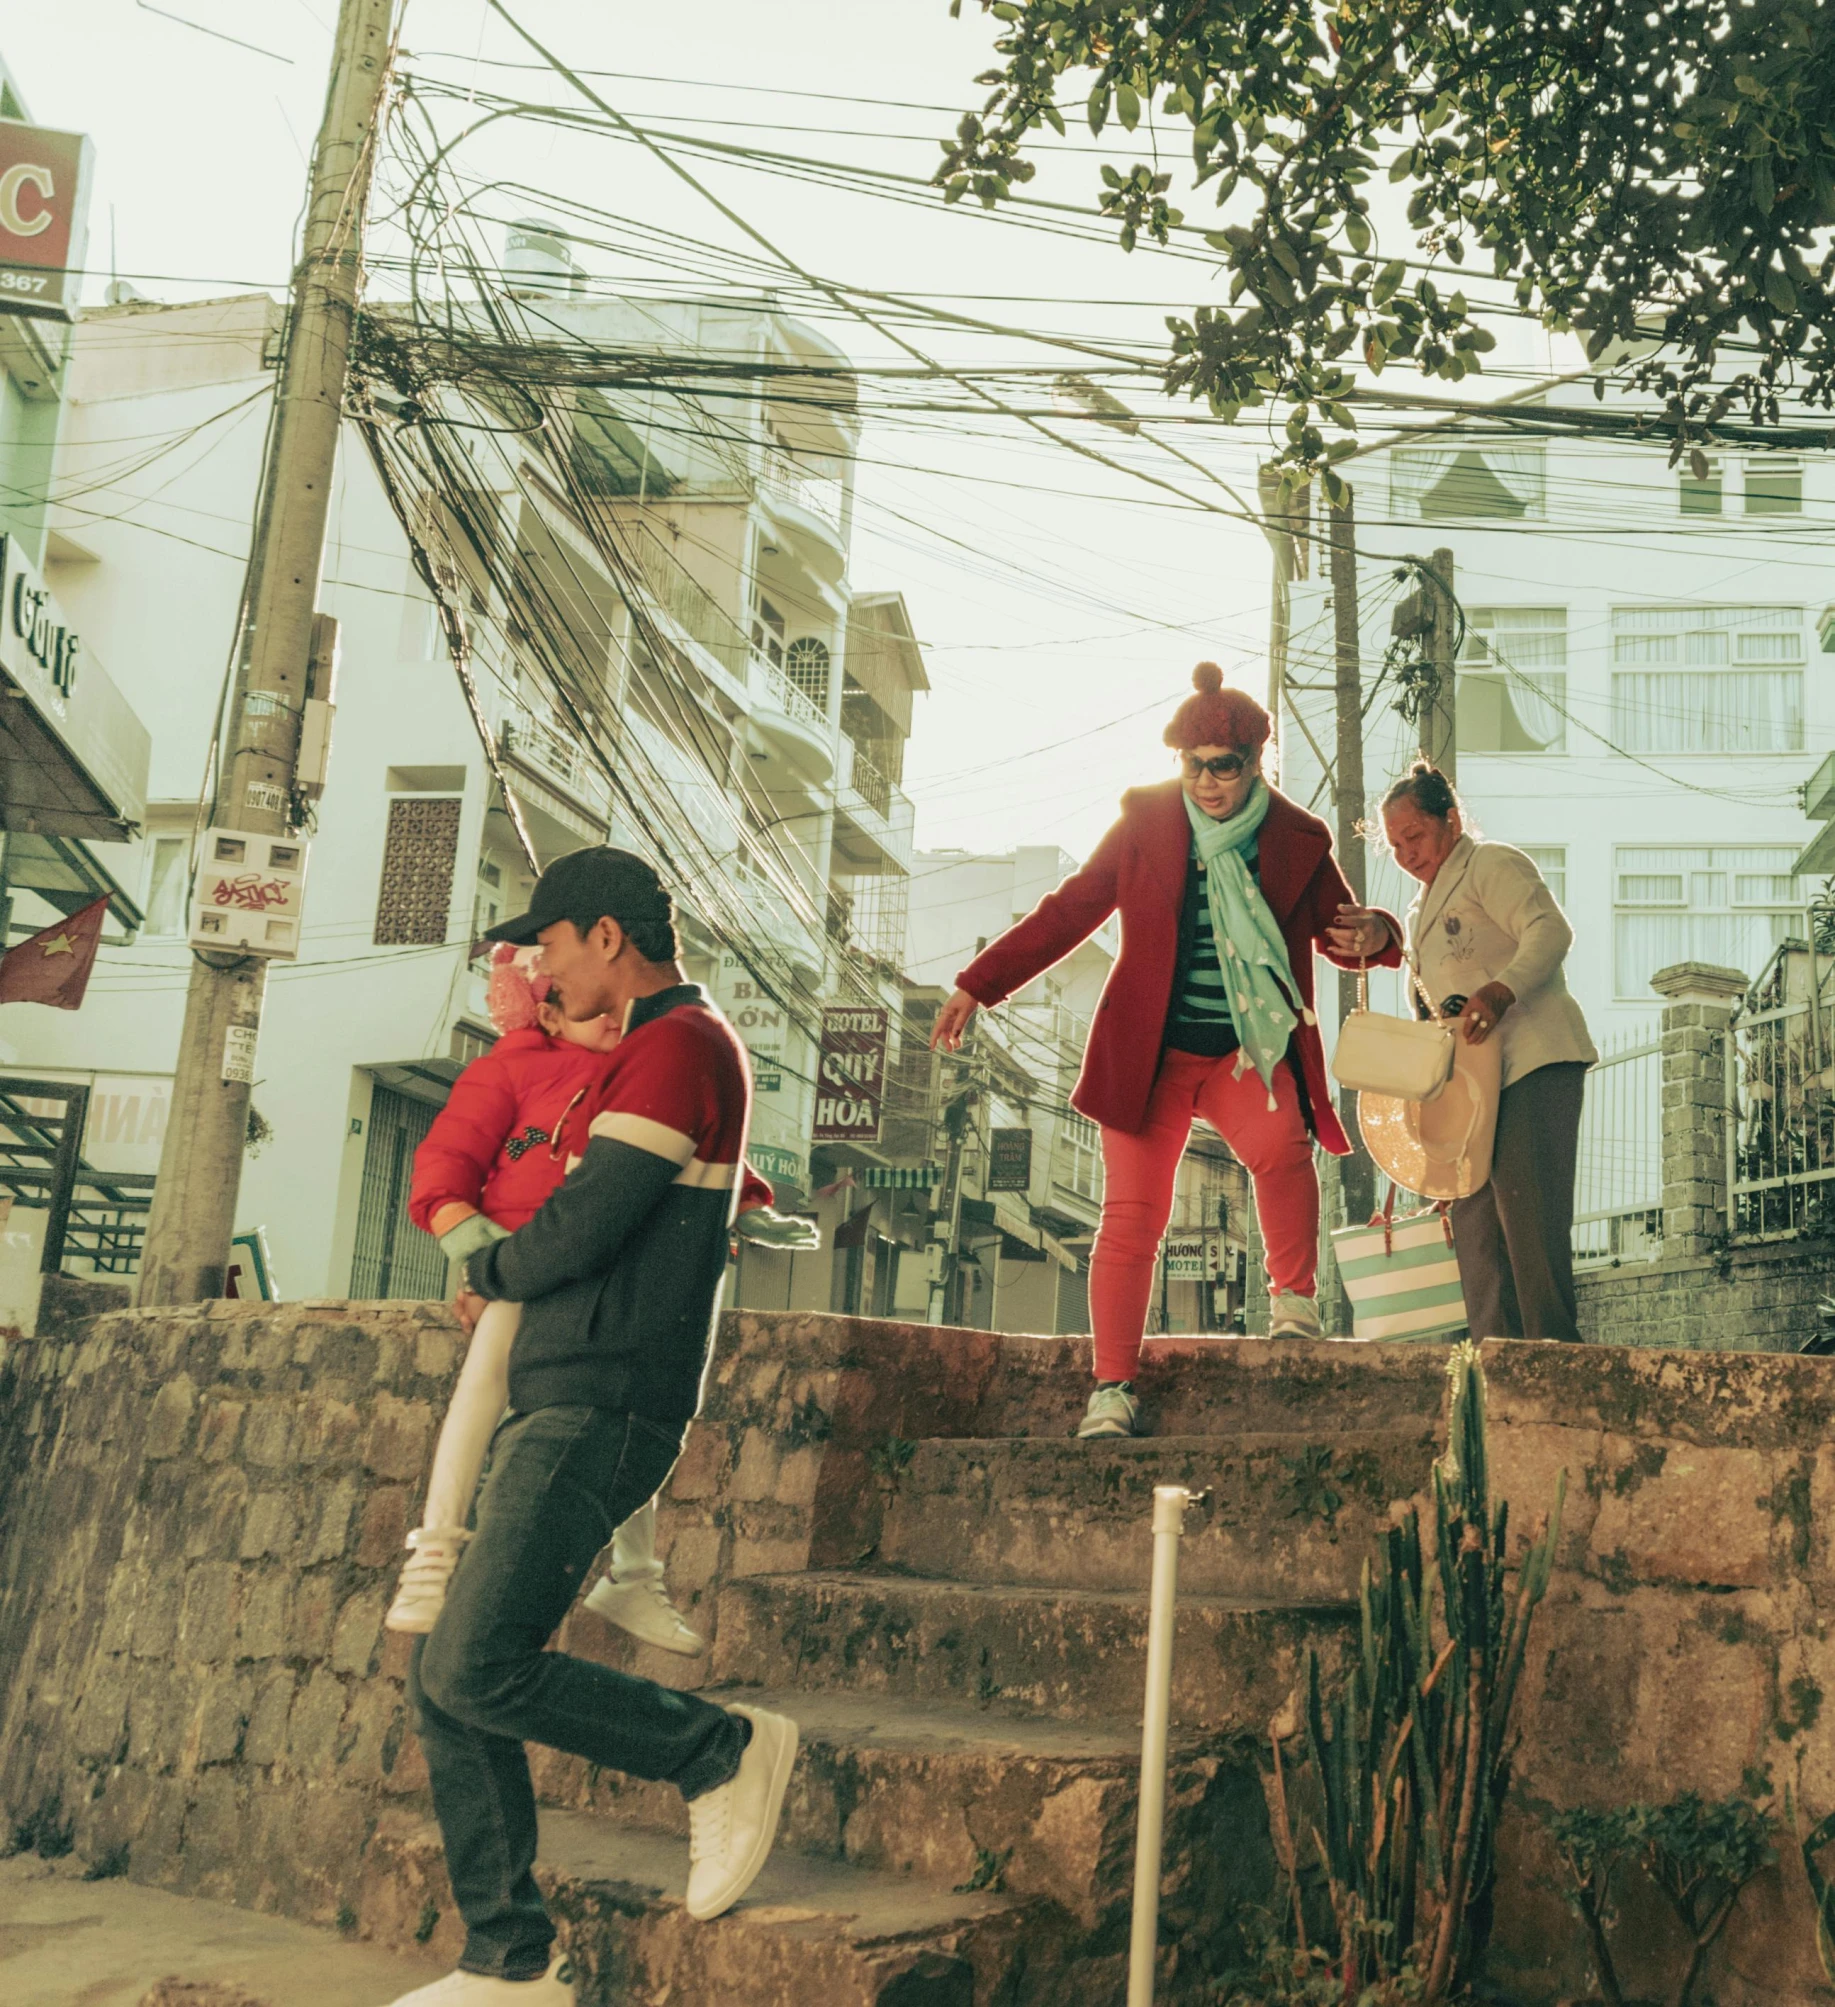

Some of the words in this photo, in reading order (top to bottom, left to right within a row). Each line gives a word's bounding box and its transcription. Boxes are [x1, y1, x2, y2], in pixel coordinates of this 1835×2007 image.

[0, 272, 48, 293] 367
[826, 1012, 881, 1033] HOTEL
[822, 1047, 879, 1087] QUÝ
[816, 1090, 875, 1127] HÒA
